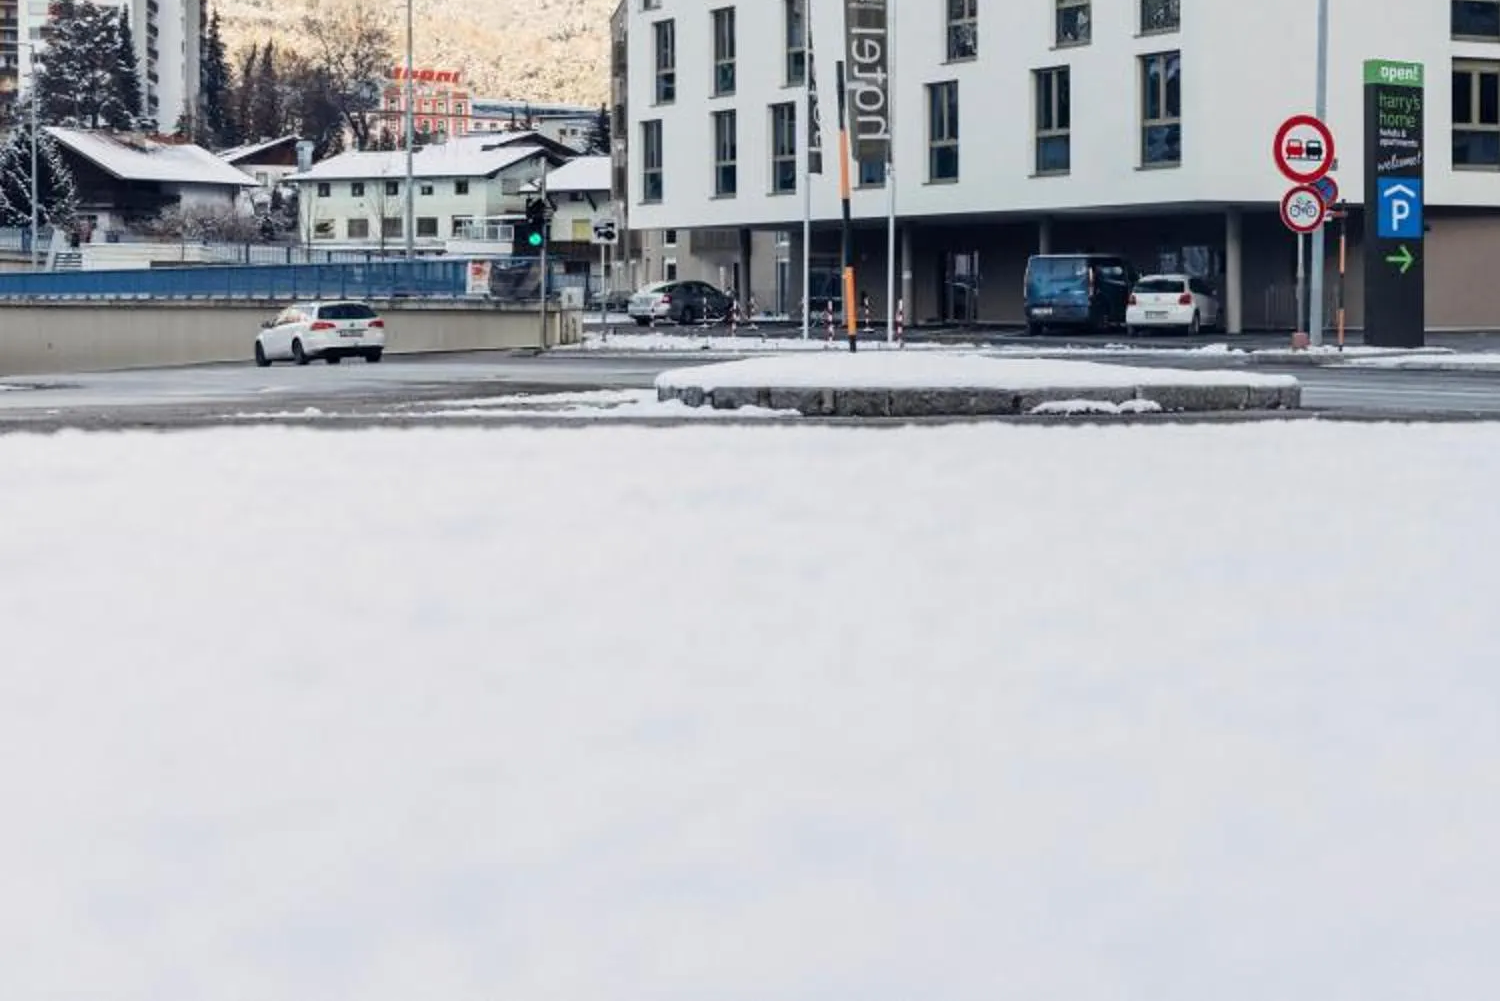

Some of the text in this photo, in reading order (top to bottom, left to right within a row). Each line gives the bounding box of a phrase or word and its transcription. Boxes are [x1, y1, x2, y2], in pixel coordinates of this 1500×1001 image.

[1380, 65, 1418, 82] open!
[1380, 90, 1421, 113] harry's
[1380, 110, 1416, 127] home
[1391, 200, 1410, 232] P
